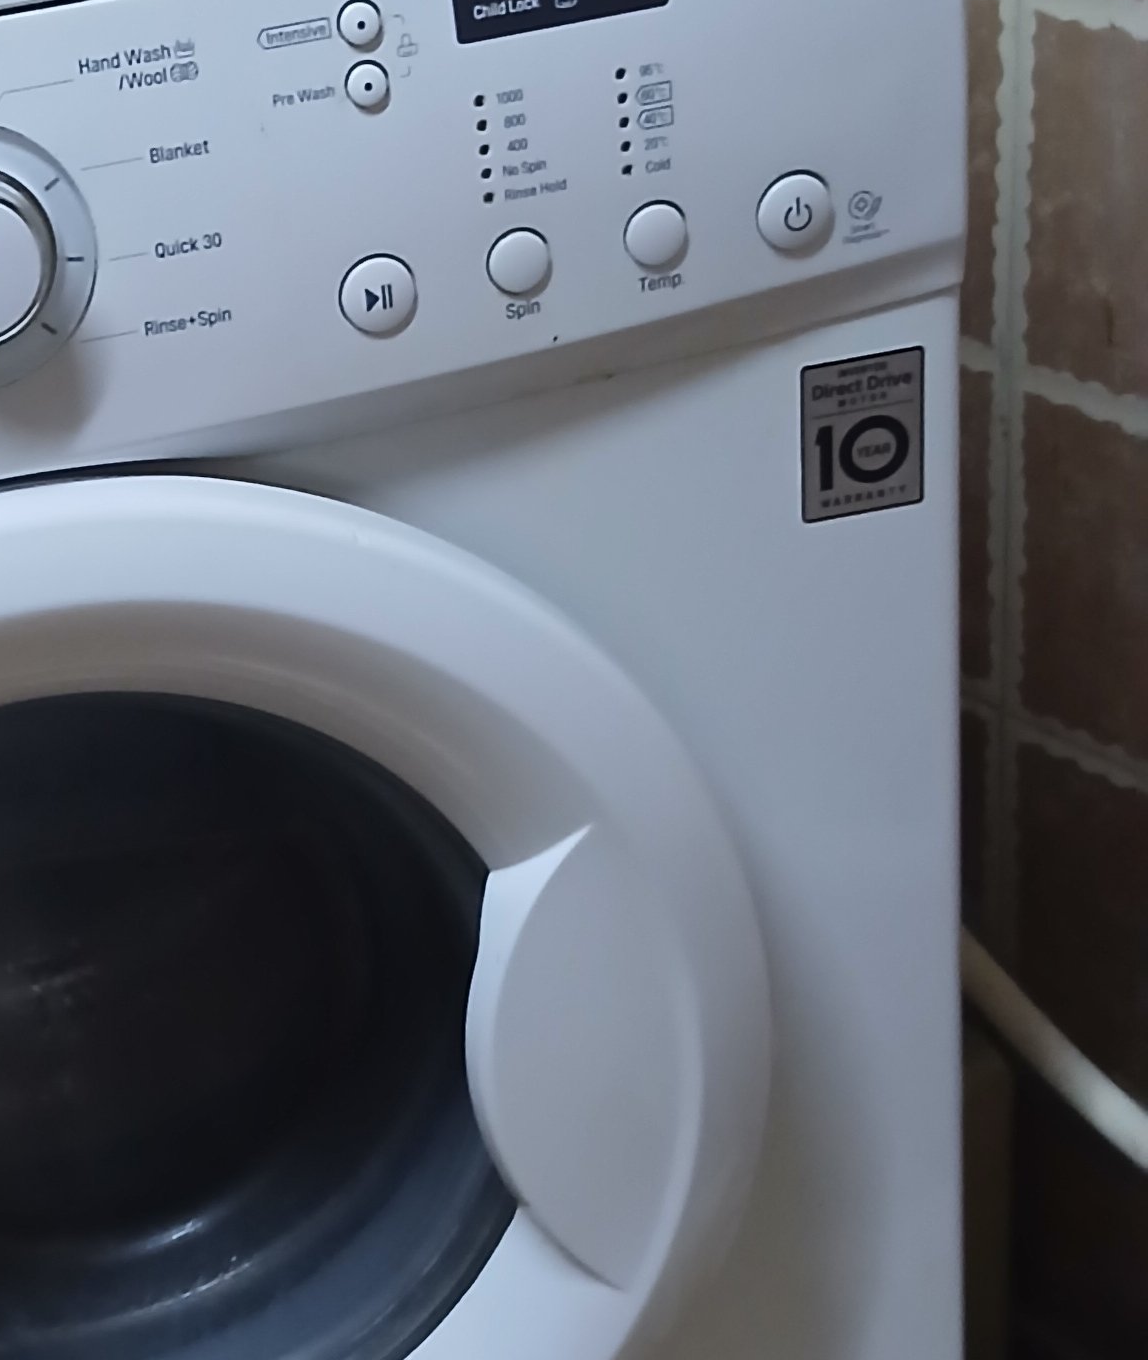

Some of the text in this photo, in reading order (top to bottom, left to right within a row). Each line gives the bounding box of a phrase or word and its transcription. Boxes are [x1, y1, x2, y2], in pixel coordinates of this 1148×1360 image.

[473, 1, 506, 20] Child
[265, 24, 327, 45] Intensive
[77, 44, 171, 75] Hand Wash
[118, 67, 168, 91] /Wool
[272, 87, 336, 108] Pre Wash
[496, 89, 524, 104] 1000
[504, 114, 526, 129] 800
[149, 139, 211, 165] Blanket
[507, 138, 528, 152] 400
[502, 160, 547, 177] No Spin
[645, 158, 671, 174] Cold
[504, 178, 568, 201] Rinse Hold
[154, 232, 223, 261] Quick 30
[505, 298, 542, 321] Spin
[144, 307, 232, 338] Rinse+Spin
[811, 371, 913, 402] Direct Drive
[815, 414, 910, 492] 10
[856, 440, 892, 459] YEAR
[821, 484, 908, 509] WARRANTY
